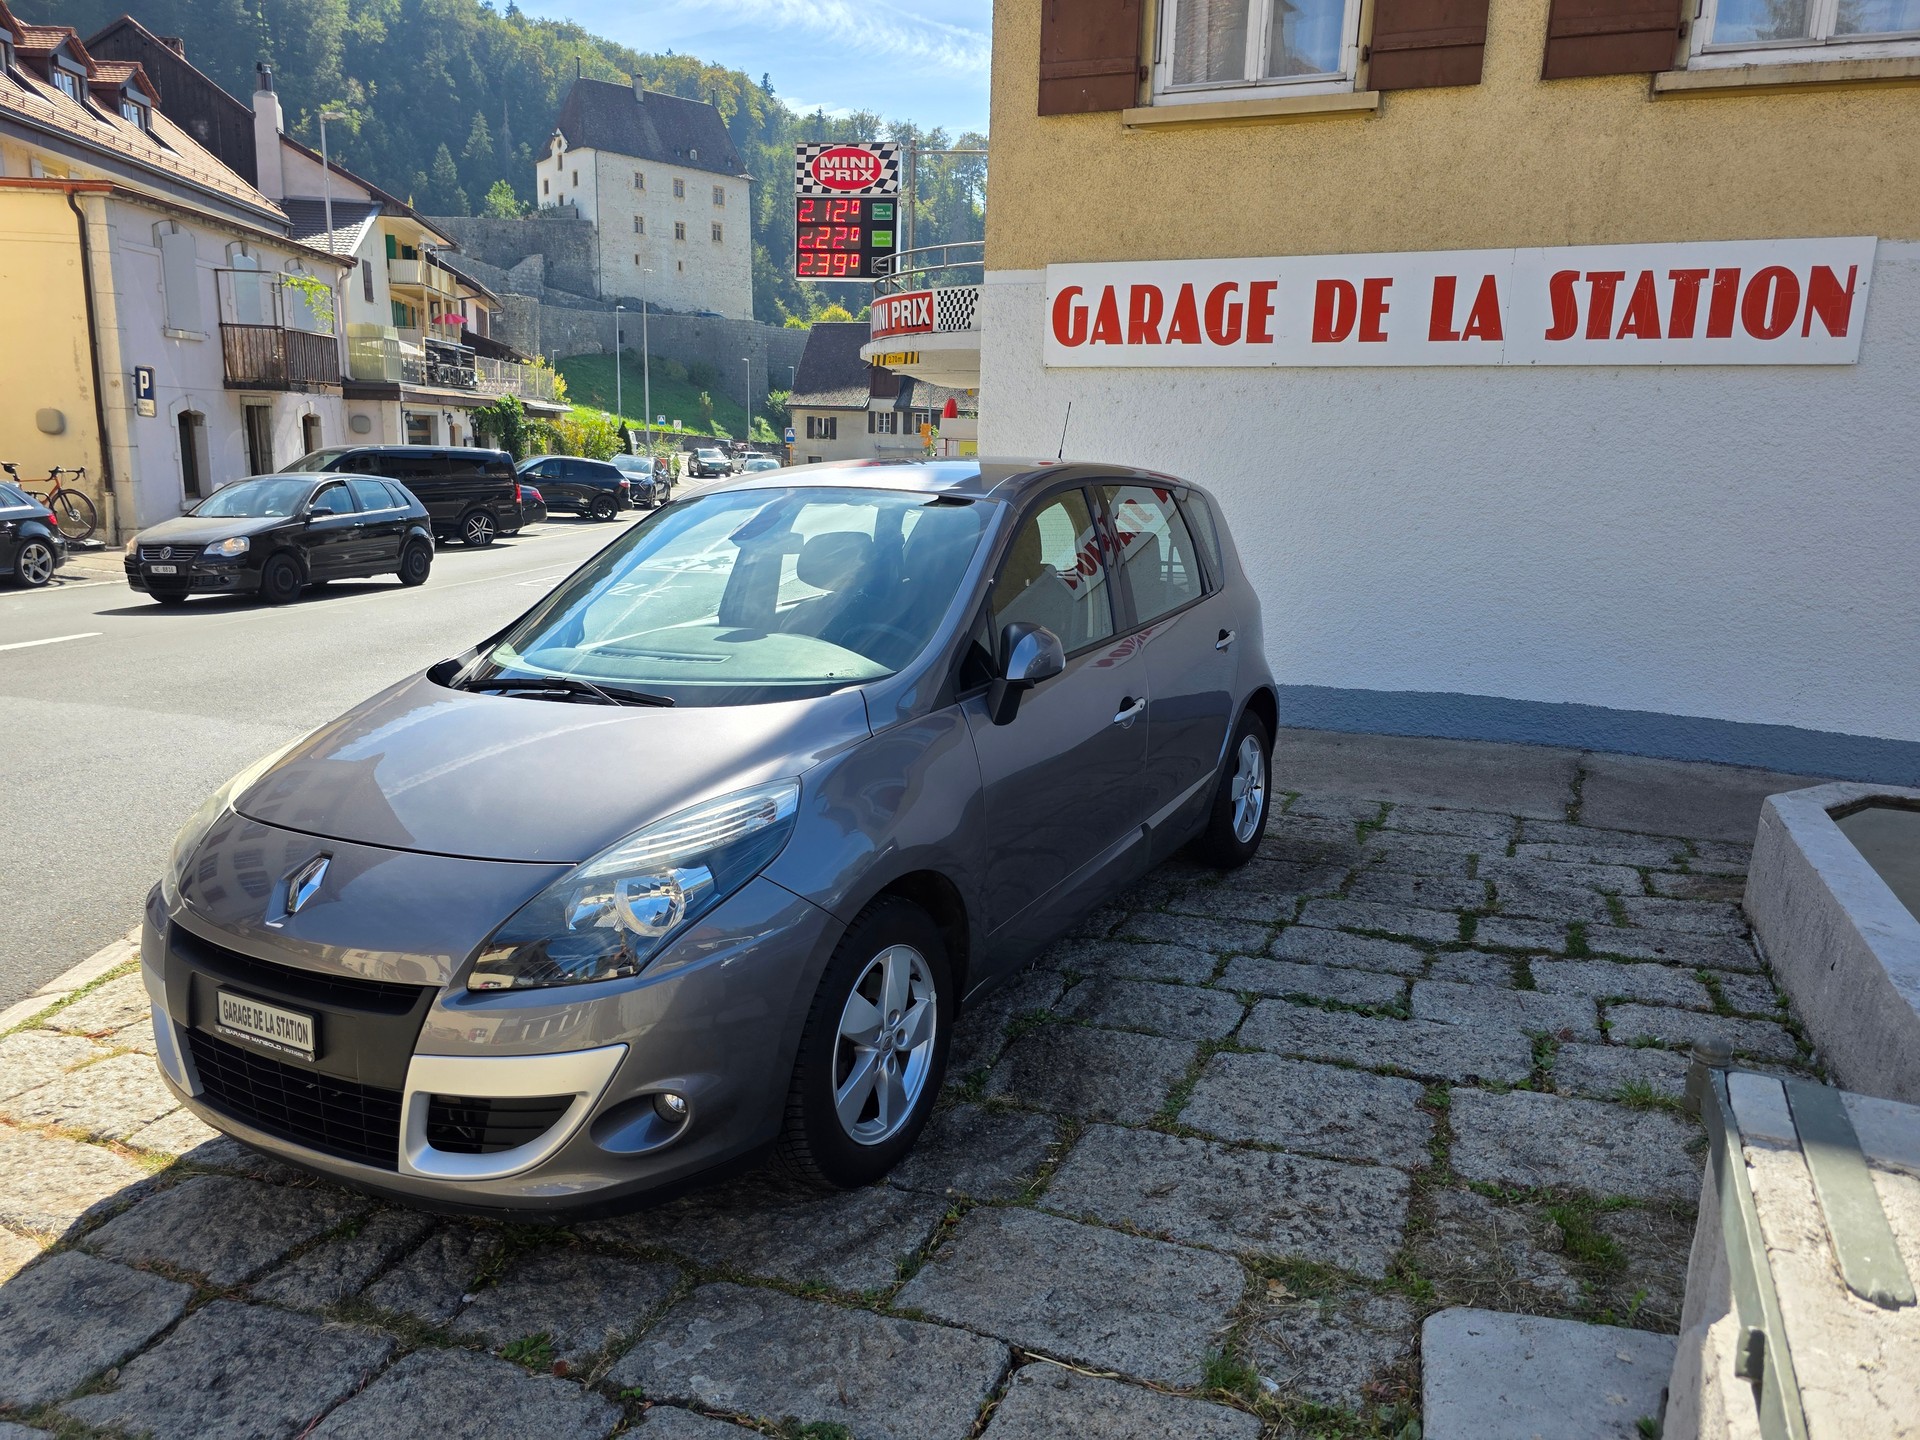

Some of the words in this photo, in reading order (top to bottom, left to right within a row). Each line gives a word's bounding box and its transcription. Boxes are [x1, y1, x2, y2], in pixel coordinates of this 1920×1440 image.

[819, 169, 875, 181] PRIX
[820, 156, 875, 169] MINI
[891, 297, 931, 328] PRIX
[1051, 280, 1279, 348] GARAGE
[1311, 277, 1394, 344] DE
[1427, 274, 1505, 342] LA
[1544, 264, 1859, 342] STATION
[139, 370, 150, 397] P
[223, 999, 252, 1028] GARAGE
[253, 1008, 263, 1031] DE
[264, 1012, 275, 1035] LA
[276, 1015, 309, 1045] STATION
